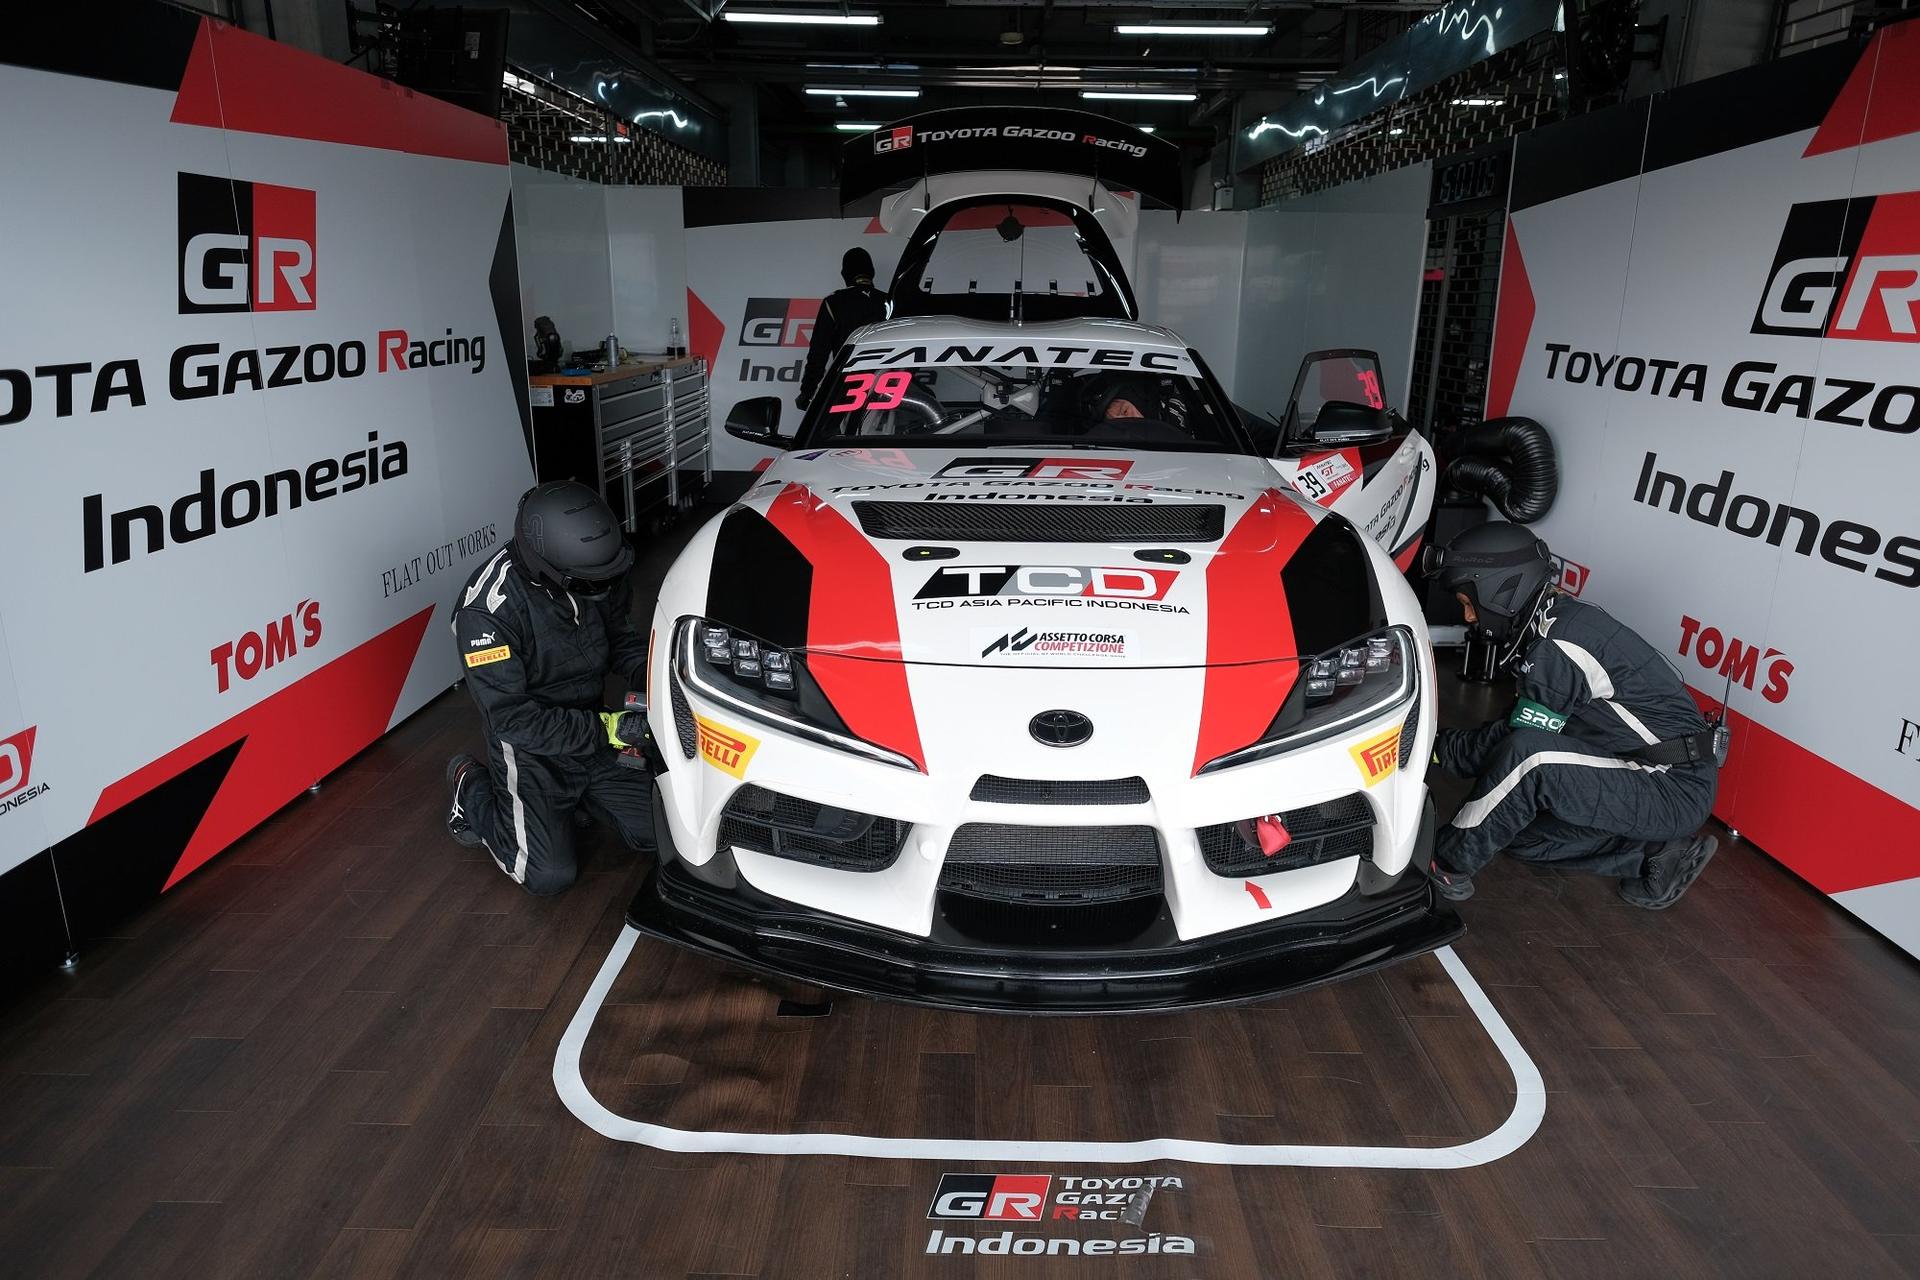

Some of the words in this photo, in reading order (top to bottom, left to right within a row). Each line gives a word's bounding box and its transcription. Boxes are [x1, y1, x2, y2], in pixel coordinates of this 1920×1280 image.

[876, 134, 911, 153] GR
[916, 127, 998, 143] TOYOTA
[1002, 126, 1076, 142] GAZOO
[1082, 135, 1148, 158] Racing
[184, 232, 313, 305] GR
[1761, 254, 1920, 334] GR
[168, 339, 367, 401] GAZOO
[377, 327, 486, 375] Racing
[842, 345, 1180, 371] FANATEC
[1545, 343, 1708, 403] TOYOTA
[829, 371, 912, 414] 39
[941, 465, 1123, 479] GR
[1298, 471, 1327, 499] 39
[83, 430, 409, 574] Indonesia
[827, 481, 971, 493] TOYOTA
[980, 480, 1115, 488] GAZOO
[1124, 483, 1245, 500] Racing
[923, 491, 1153, 504] Indonesia
[381, 557, 422, 599] FLAT
[425, 542, 456, 575] OUT
[456, 522, 498, 560] WORKS
[942, 566, 1158, 599] TCD
[912, 600, 953, 610] TCD
[960, 599, 1002, 607] ASIA
[1008, 598, 1082, 607] PACIFIC
[1087, 600, 1190, 614] INDONESIA
[210, 597, 323, 695] TOM'S
[470, 638, 492, 647] PUMA
[1034, 641, 1125, 654] COMPETIZIONE
[1039, 632, 1088, 642] ASSETTO
[1088, 633, 1125, 644] CORSA
[468, 648, 508, 665] PIRELLI
[1520, 707, 1562, 730] SRO
[1058, 1176, 1183, 1190] TOYOTA
[934, 1191, 1042, 1217] GR
[925, 1230, 1196, 1256] Indonesia
